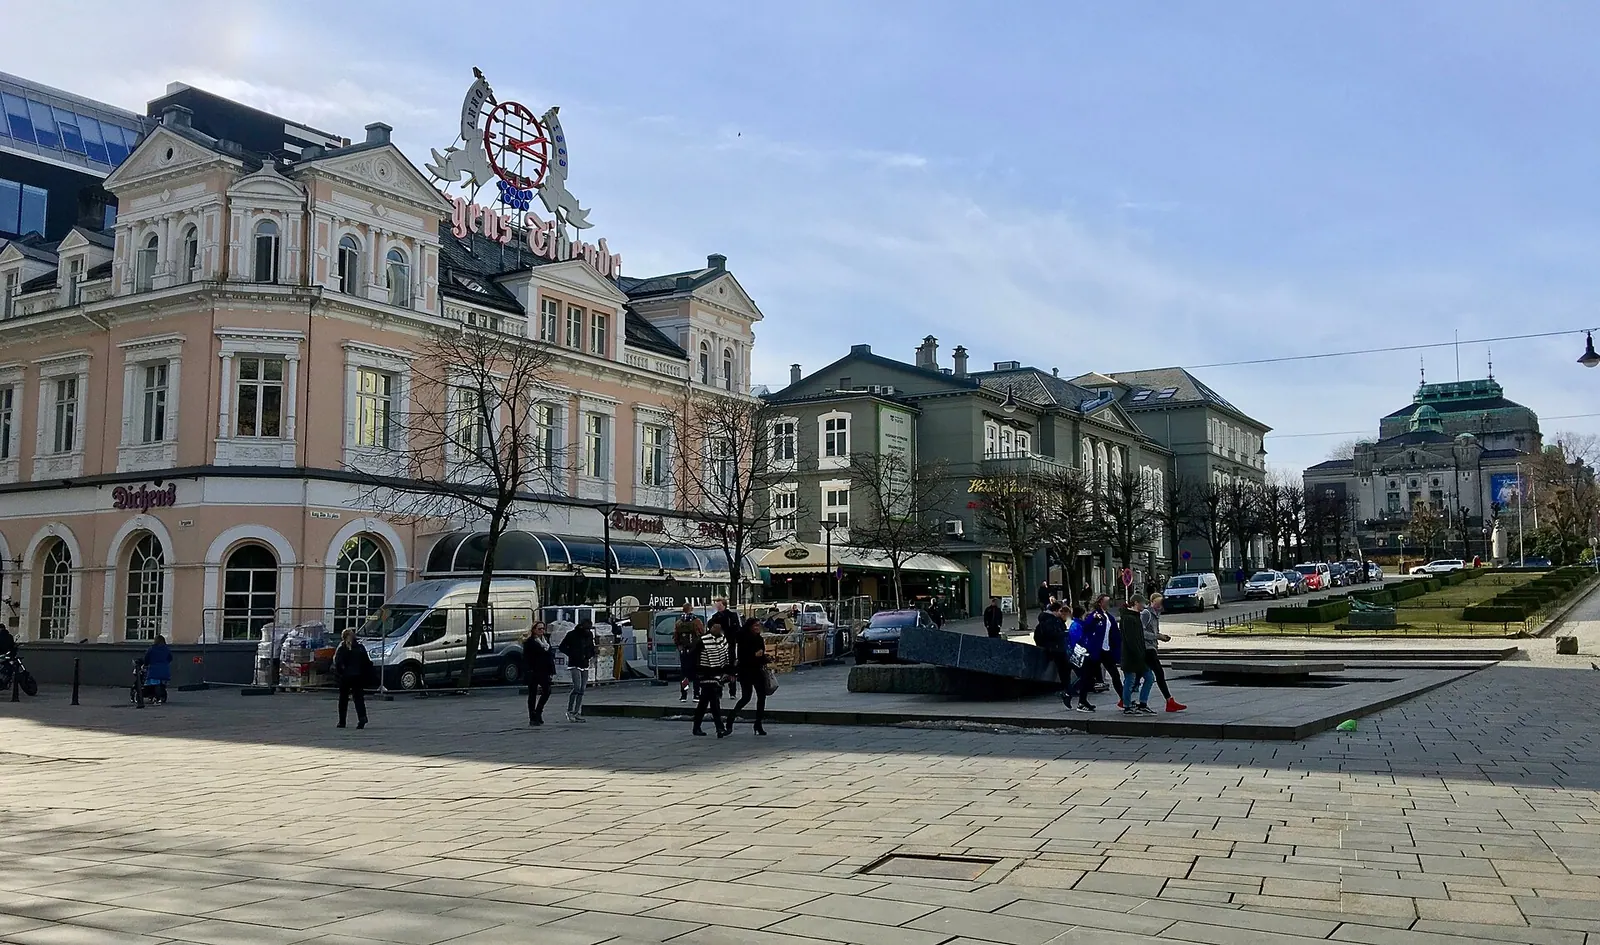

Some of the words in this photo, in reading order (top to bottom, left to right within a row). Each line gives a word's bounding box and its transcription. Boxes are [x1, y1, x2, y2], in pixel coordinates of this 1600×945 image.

[466, 88, 483, 130] ANNO
[445, 193, 512, 244] gens
[112, 482, 177, 513] Dickens
[648, 593, 675, 607] ÅPNER
